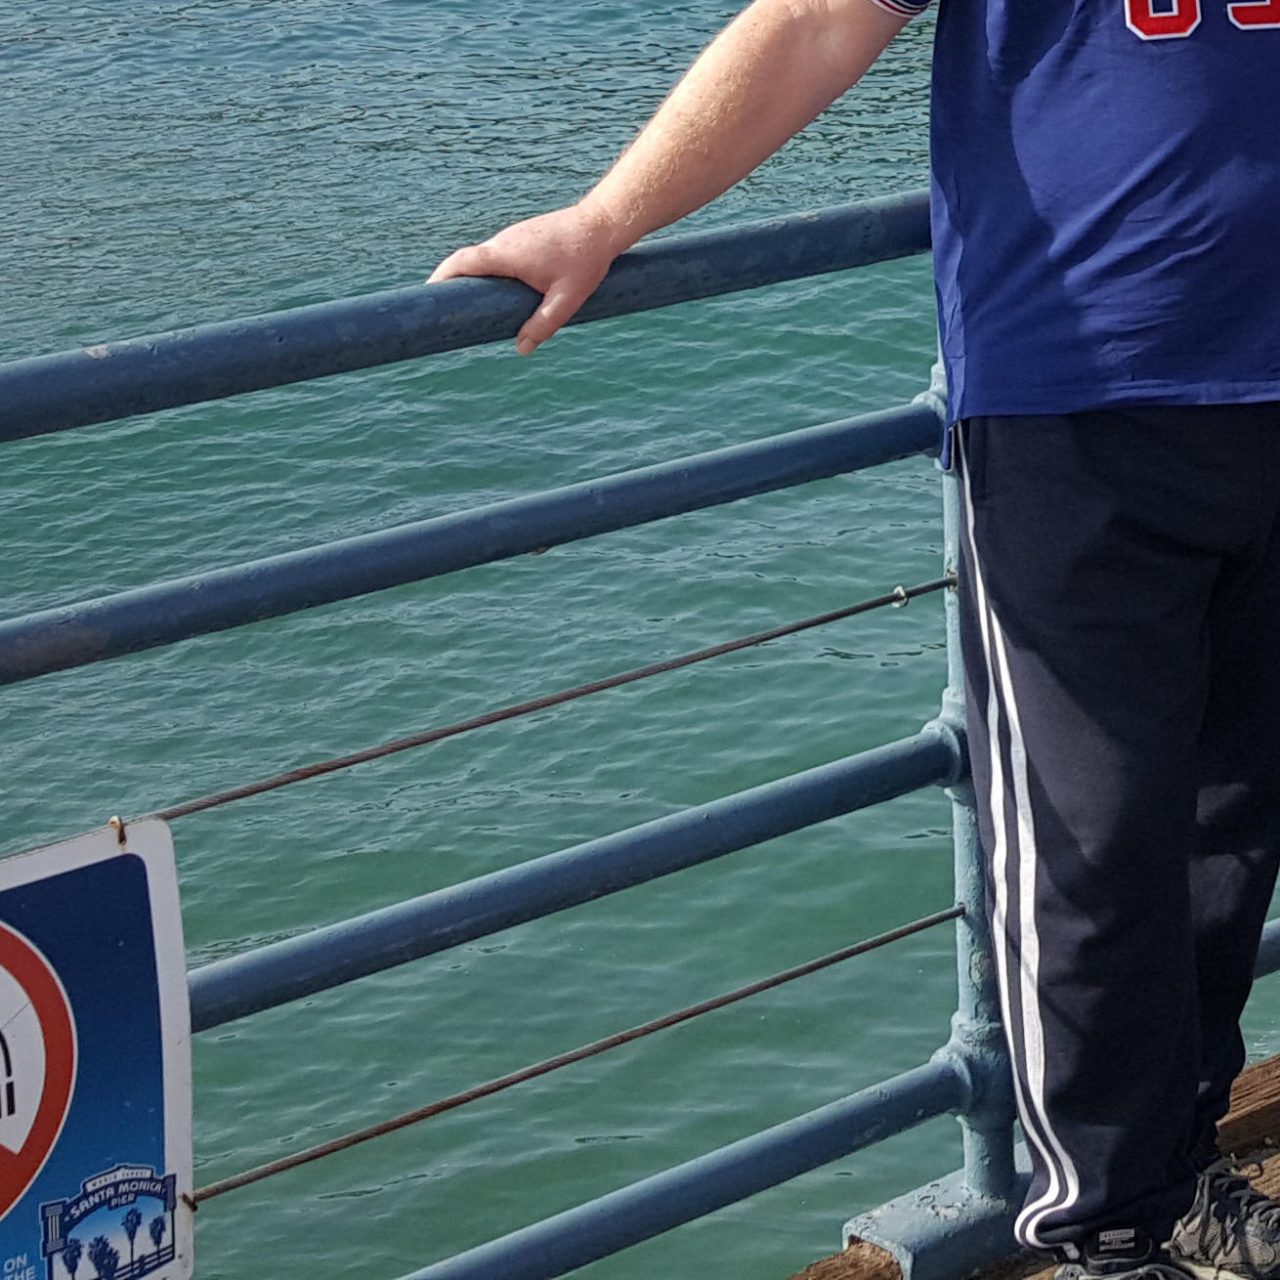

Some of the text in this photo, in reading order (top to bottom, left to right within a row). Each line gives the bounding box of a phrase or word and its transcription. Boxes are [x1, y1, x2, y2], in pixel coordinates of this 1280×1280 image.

[70, 1181, 162, 1219] SANTA MONICA
[111, 1193, 135, 1207] PIER
[4, 1253, 28, 1273] ON
